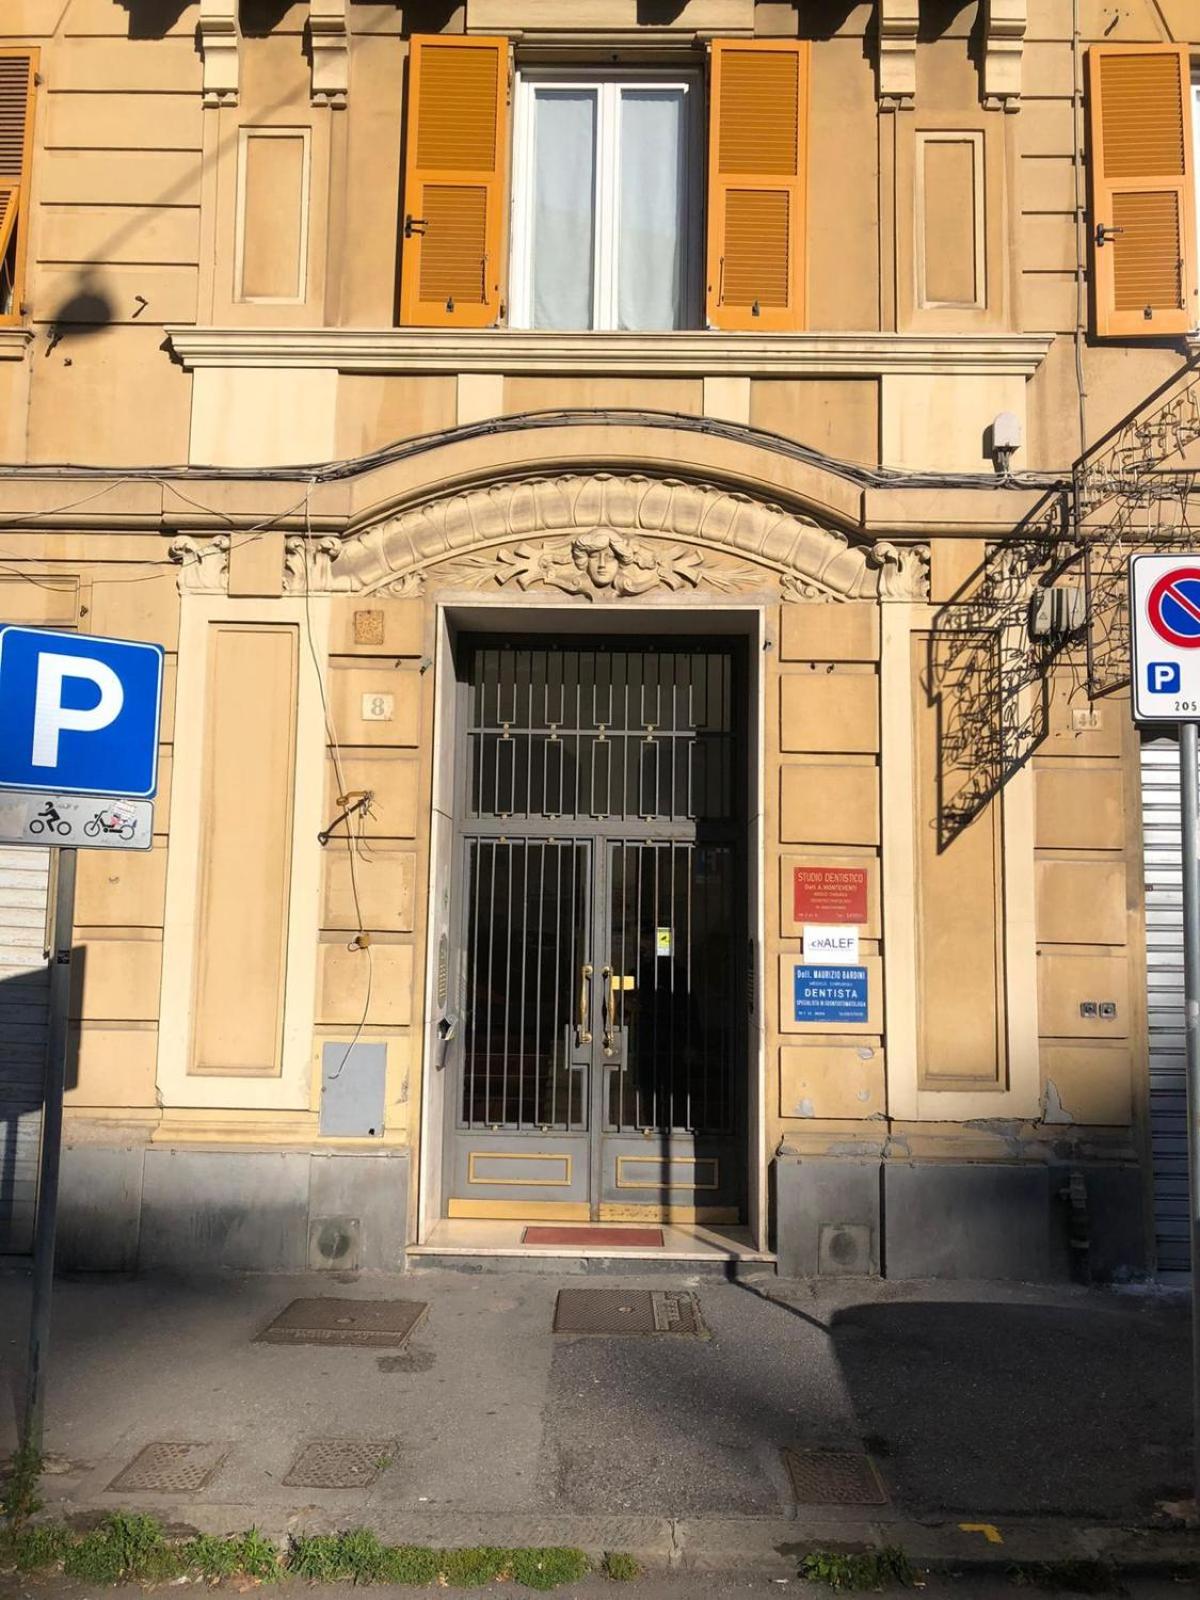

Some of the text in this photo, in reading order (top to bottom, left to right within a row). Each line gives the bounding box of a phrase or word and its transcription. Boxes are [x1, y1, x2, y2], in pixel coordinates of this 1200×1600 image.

[1155, 666, 1175, 690] P
[32, 652, 124, 767] P
[371, 697, 384, 716] 8
[797, 871, 864, 883] STUDIO DENTISTICO
[813, 970, 841, 979] MAURIZIO
[804, 988, 858, 998] DENTISTA
